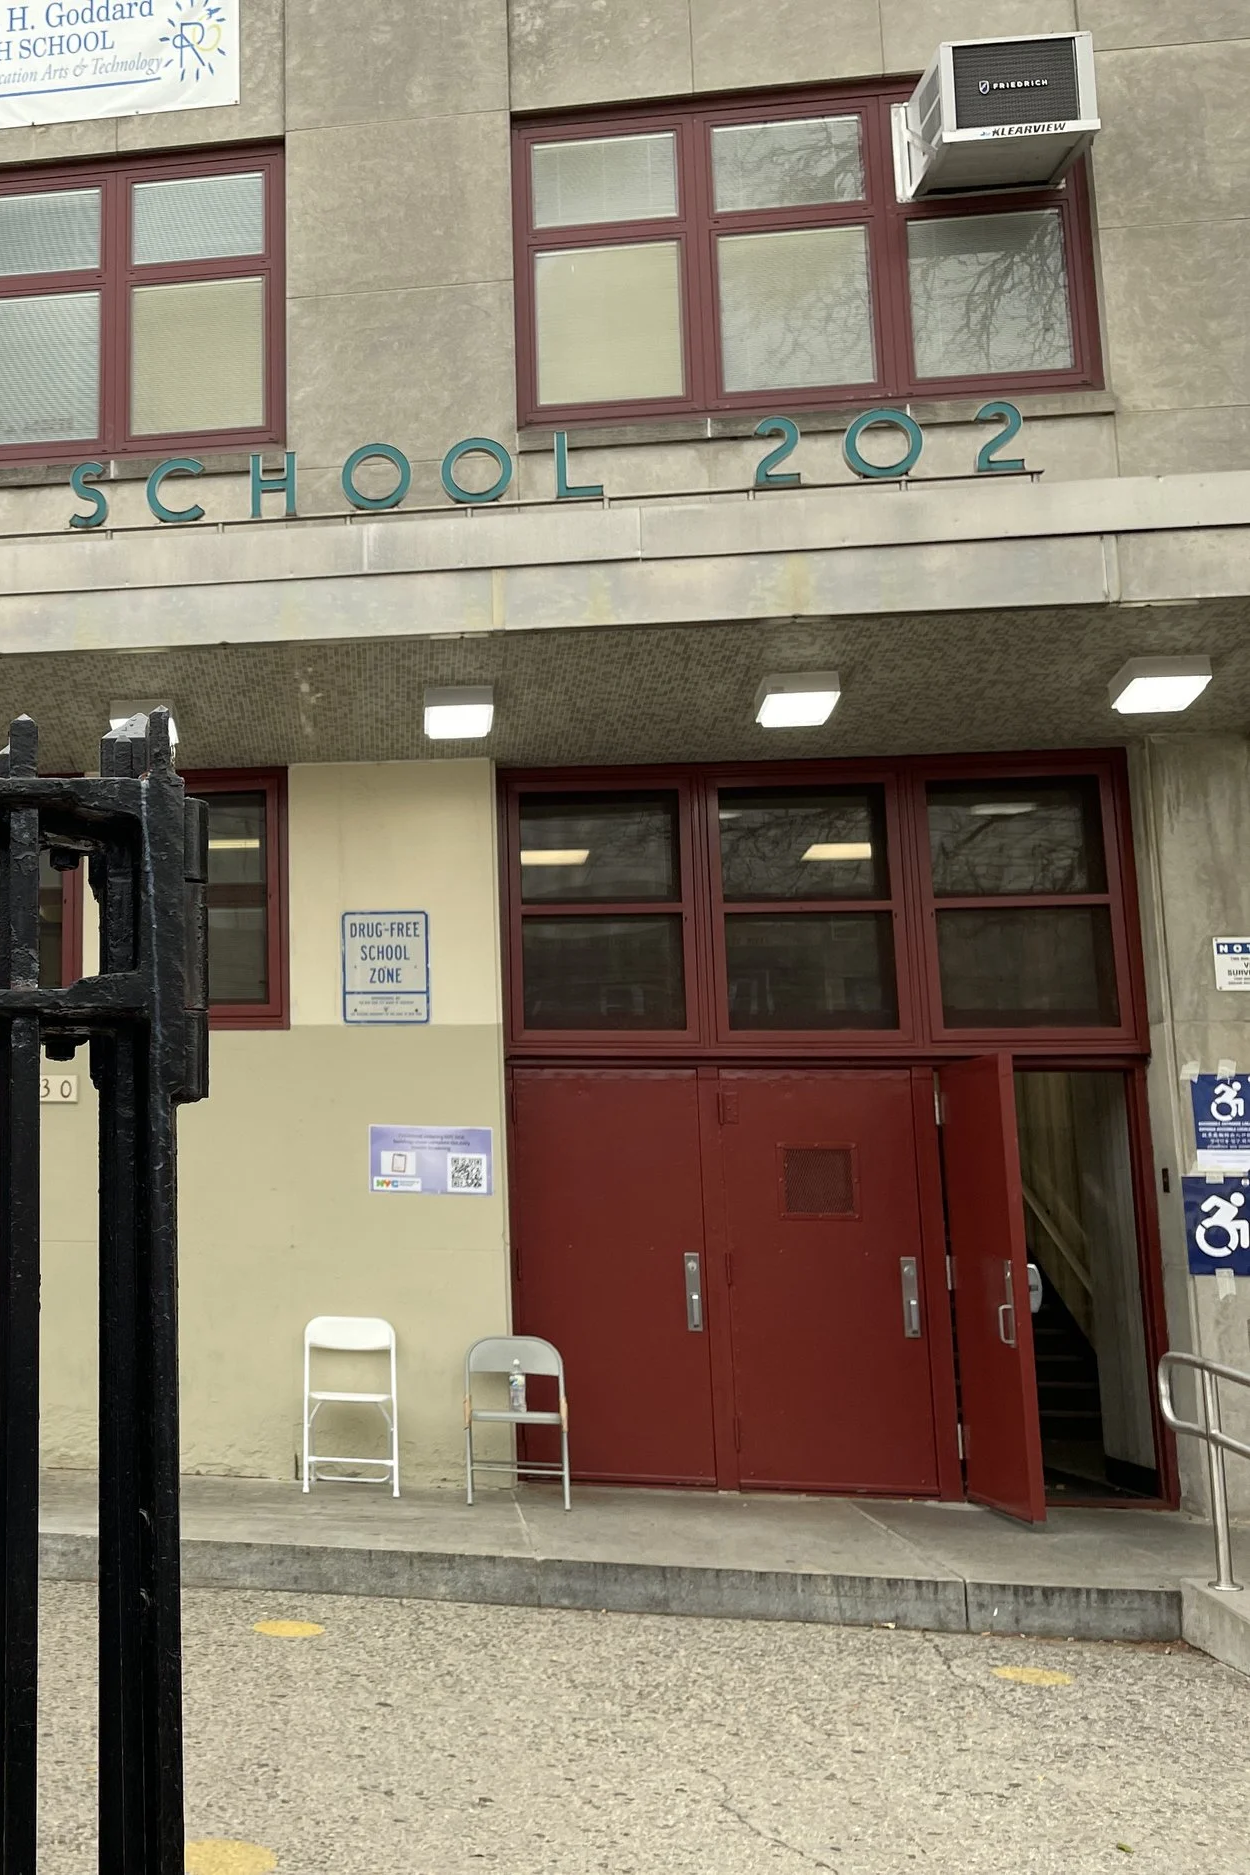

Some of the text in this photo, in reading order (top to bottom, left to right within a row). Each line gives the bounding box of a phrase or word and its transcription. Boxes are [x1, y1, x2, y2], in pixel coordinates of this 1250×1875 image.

[6, 6, 36, 33] H.
[45, 0, 154, 28] Goddard
[19, 30, 115, 59] SCHOOL
[41, 64, 69, 81] Arts
[72, 57, 88, 77] &
[91, 52, 163, 76] Technology
[992, 79, 1048, 90] FRIEDRICH
[991, 122, 1067, 137] KLEARVIEW
[69, 431, 604, 529] SCHOOL
[753, 402, 1025, 487] 202
[350, 922, 420, 938] DRUG-FREE
[360, 944, 410, 961] SCHOOL
[369, 967, 402, 983] ZONE
